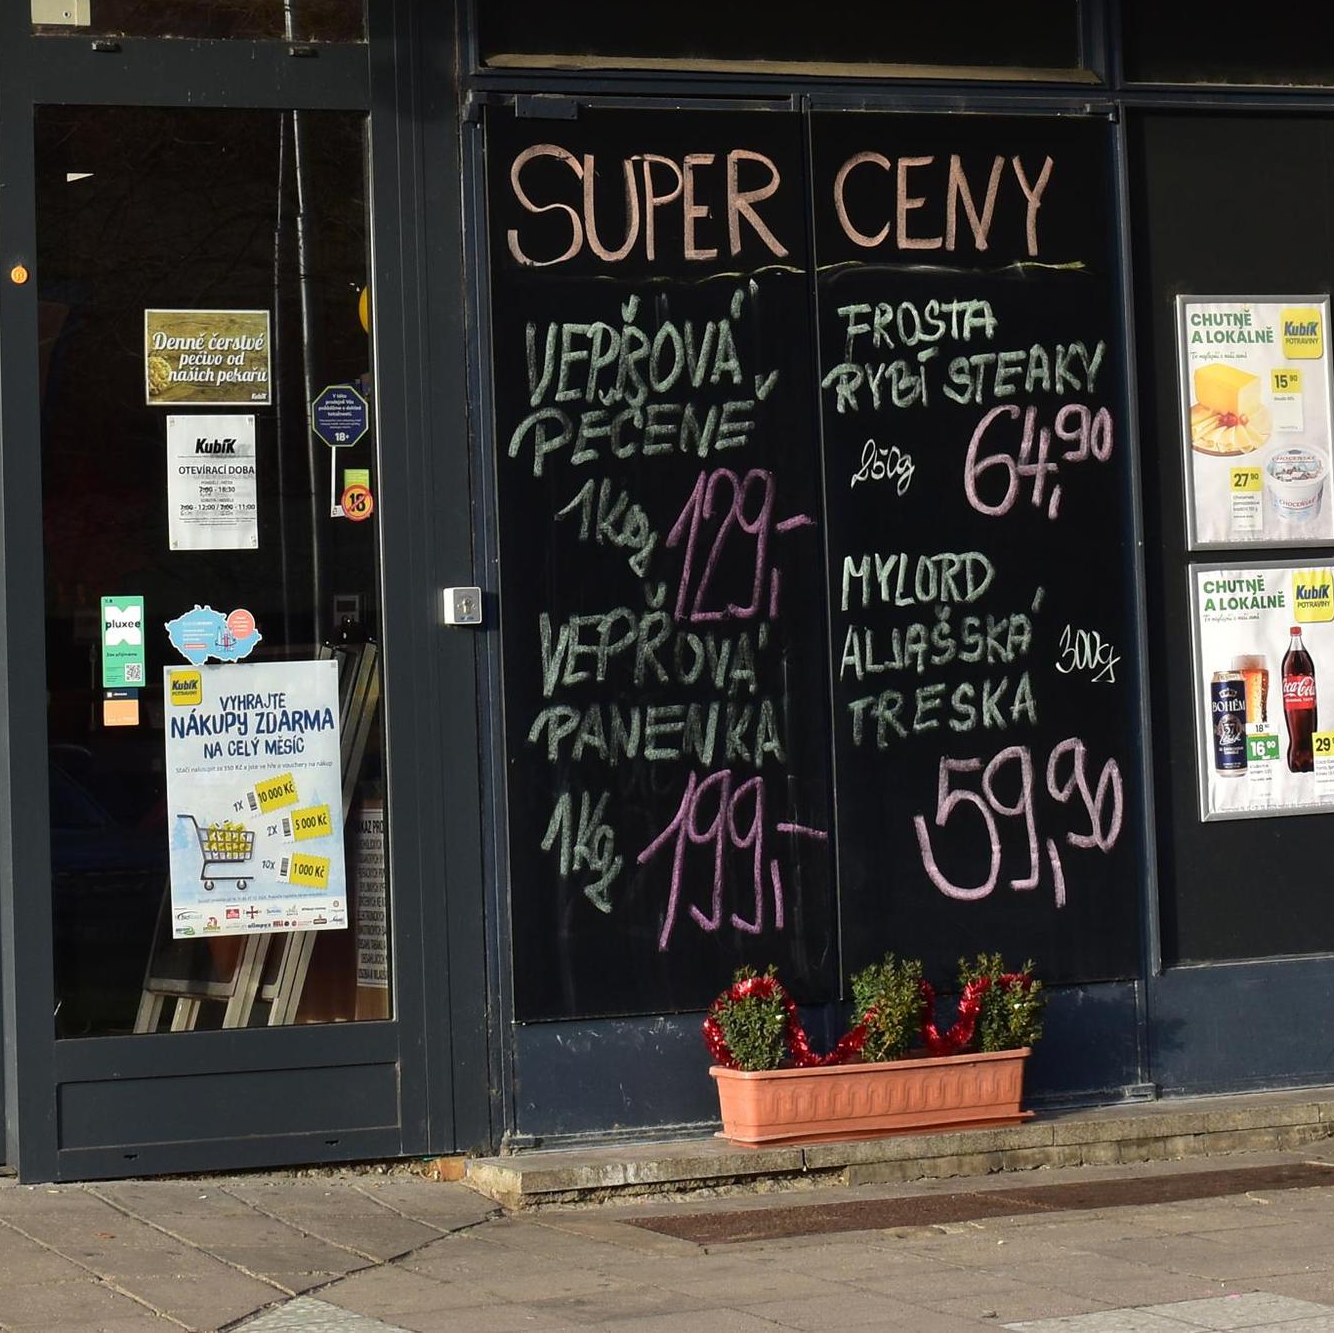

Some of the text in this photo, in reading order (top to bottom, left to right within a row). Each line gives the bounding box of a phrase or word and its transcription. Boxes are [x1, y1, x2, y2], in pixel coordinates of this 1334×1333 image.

[507, 143, 1054, 267] SUPER CENY
[1191, 310, 1252, 327] CHUTNĚ
[153, 331, 264, 350] Denně čerstvé
[837, 299, 998, 365] FROSTA
[1191, 326, 1274, 344] A LOKÁLNĚ
[1285, 337, 1319, 345] POTRAVINY
[525, 279, 759, 409] VEPŘOVÁ
[179, 351, 244, 369] pečivo od
[168, 366, 214, 382] našich
[822, 341, 1106, 414] RYBÍ STEAKY
[1274, 374, 1288, 389] 15
[179, 464, 255, 475] OTEVÍRACÍ DOBA
[1233, 472, 1249, 488] 27
[350, 493, 366, 512] 18
[841, 552, 996, 611] MYLORD
[1203, 575, 1265, 594] CHUTNĚ
[1204, 591, 1286, 612] A LOKÁLNĚ
[1297, 600, 1331, 609] POTRAVINY
[105, 619, 141, 631] pluxee
[539, 582, 768, 698] VEPŘOVÁ
[219, 693, 286, 711] VYHRAJTE
[846, 672, 1038, 750] TRESKA
[171, 707, 335, 739] NÁKUPY ZDARMA
[1255, 724, 1264, 733] 18
[527, 699, 787, 766] PANENKA
[203, 735, 305, 759] NA CELÝ MĚSÍC
[1250, 741, 1265, 757] 16
[1315, 737, 1331, 752] 29
[268, 787, 283, 799] 000
[283, 780, 295, 795] Kč
[295, 819, 300, 830] 5
[301, 816, 316, 828] 000
[317, 812, 328, 826] Kč
[298, 863, 314, 875] 000
[315, 865, 325, 878] Kč
